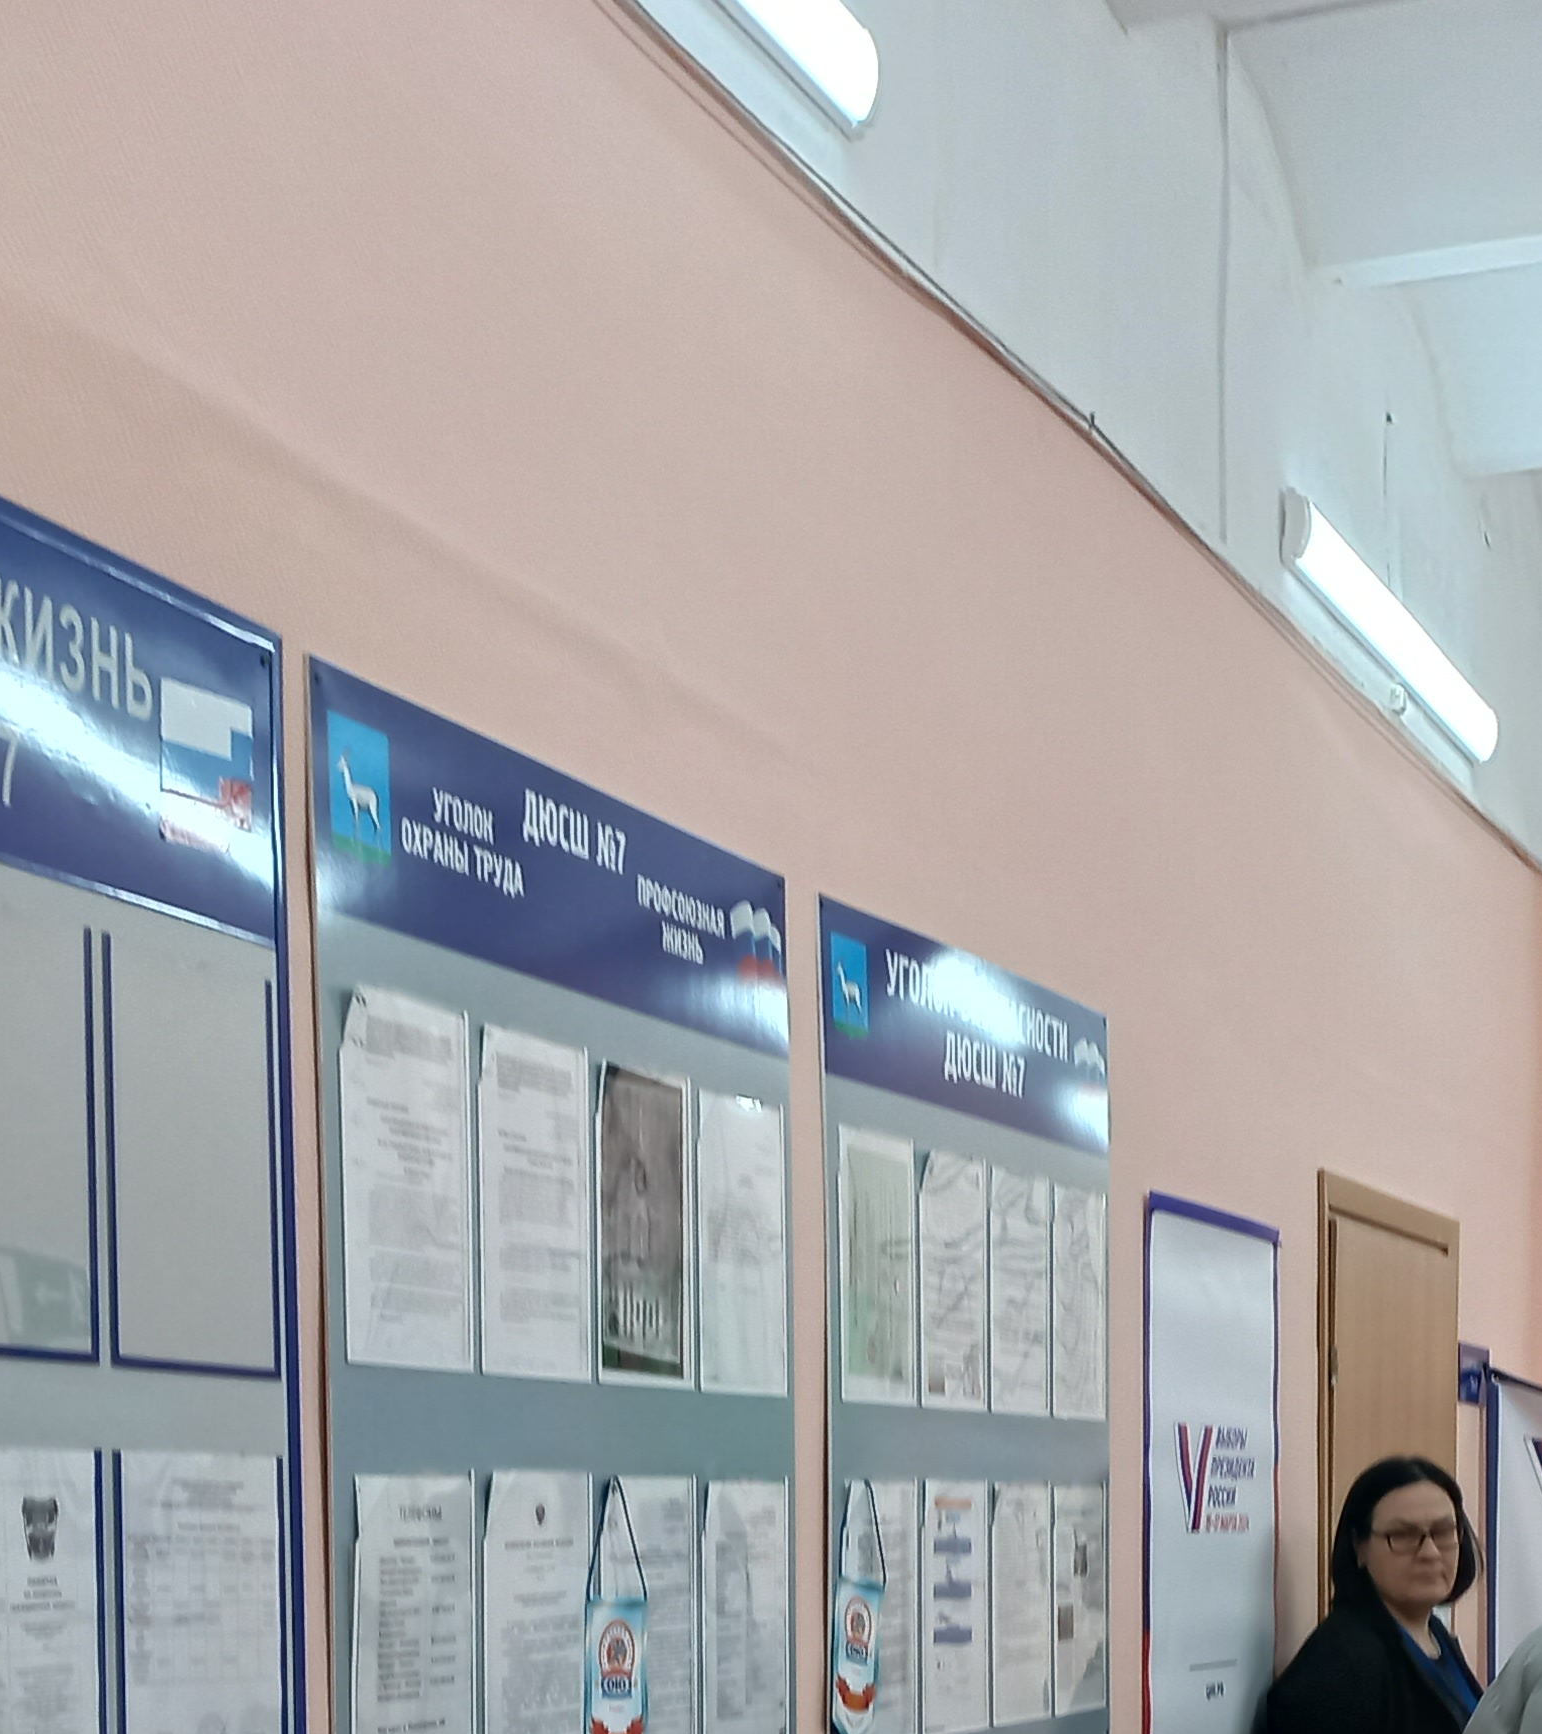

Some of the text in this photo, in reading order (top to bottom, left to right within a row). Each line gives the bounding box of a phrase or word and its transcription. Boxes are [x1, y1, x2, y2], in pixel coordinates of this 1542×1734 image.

[401, 816, 525, 899] ОХРАНЫ ТРУДА
[522, 788, 591, 861] ДЮСШ
[637, 873, 726, 940] ПРОФСОЮЗНАЯ
[662, 920, 704, 965] ЖИЗНЬ
[885, 948, 956, 1019] УГОЛ
[944, 1030, 997, 1089] ДЮСШ
